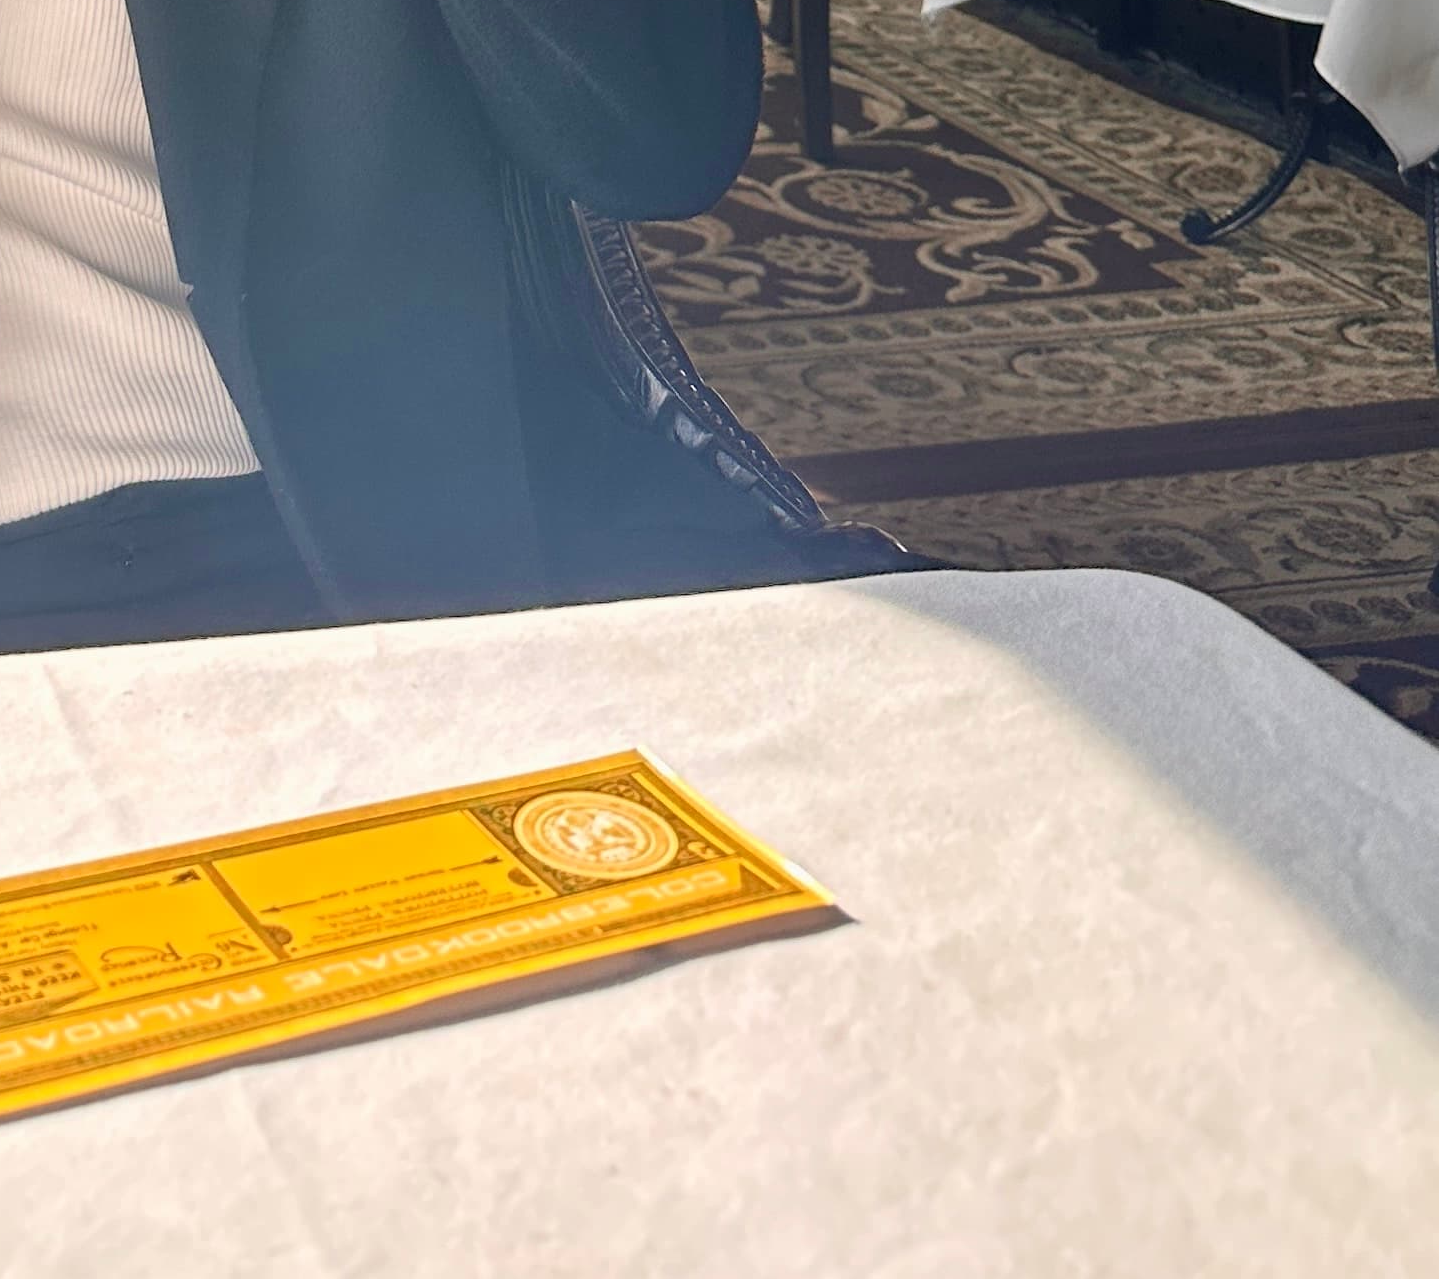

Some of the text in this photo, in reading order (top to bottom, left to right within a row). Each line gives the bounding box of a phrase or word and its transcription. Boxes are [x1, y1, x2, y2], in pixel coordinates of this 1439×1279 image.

[280, 868, 734, 992] COLEBROOKDALE
[18, 965, 44, 978] IN
[34, 970, 83, 987] KEEP
